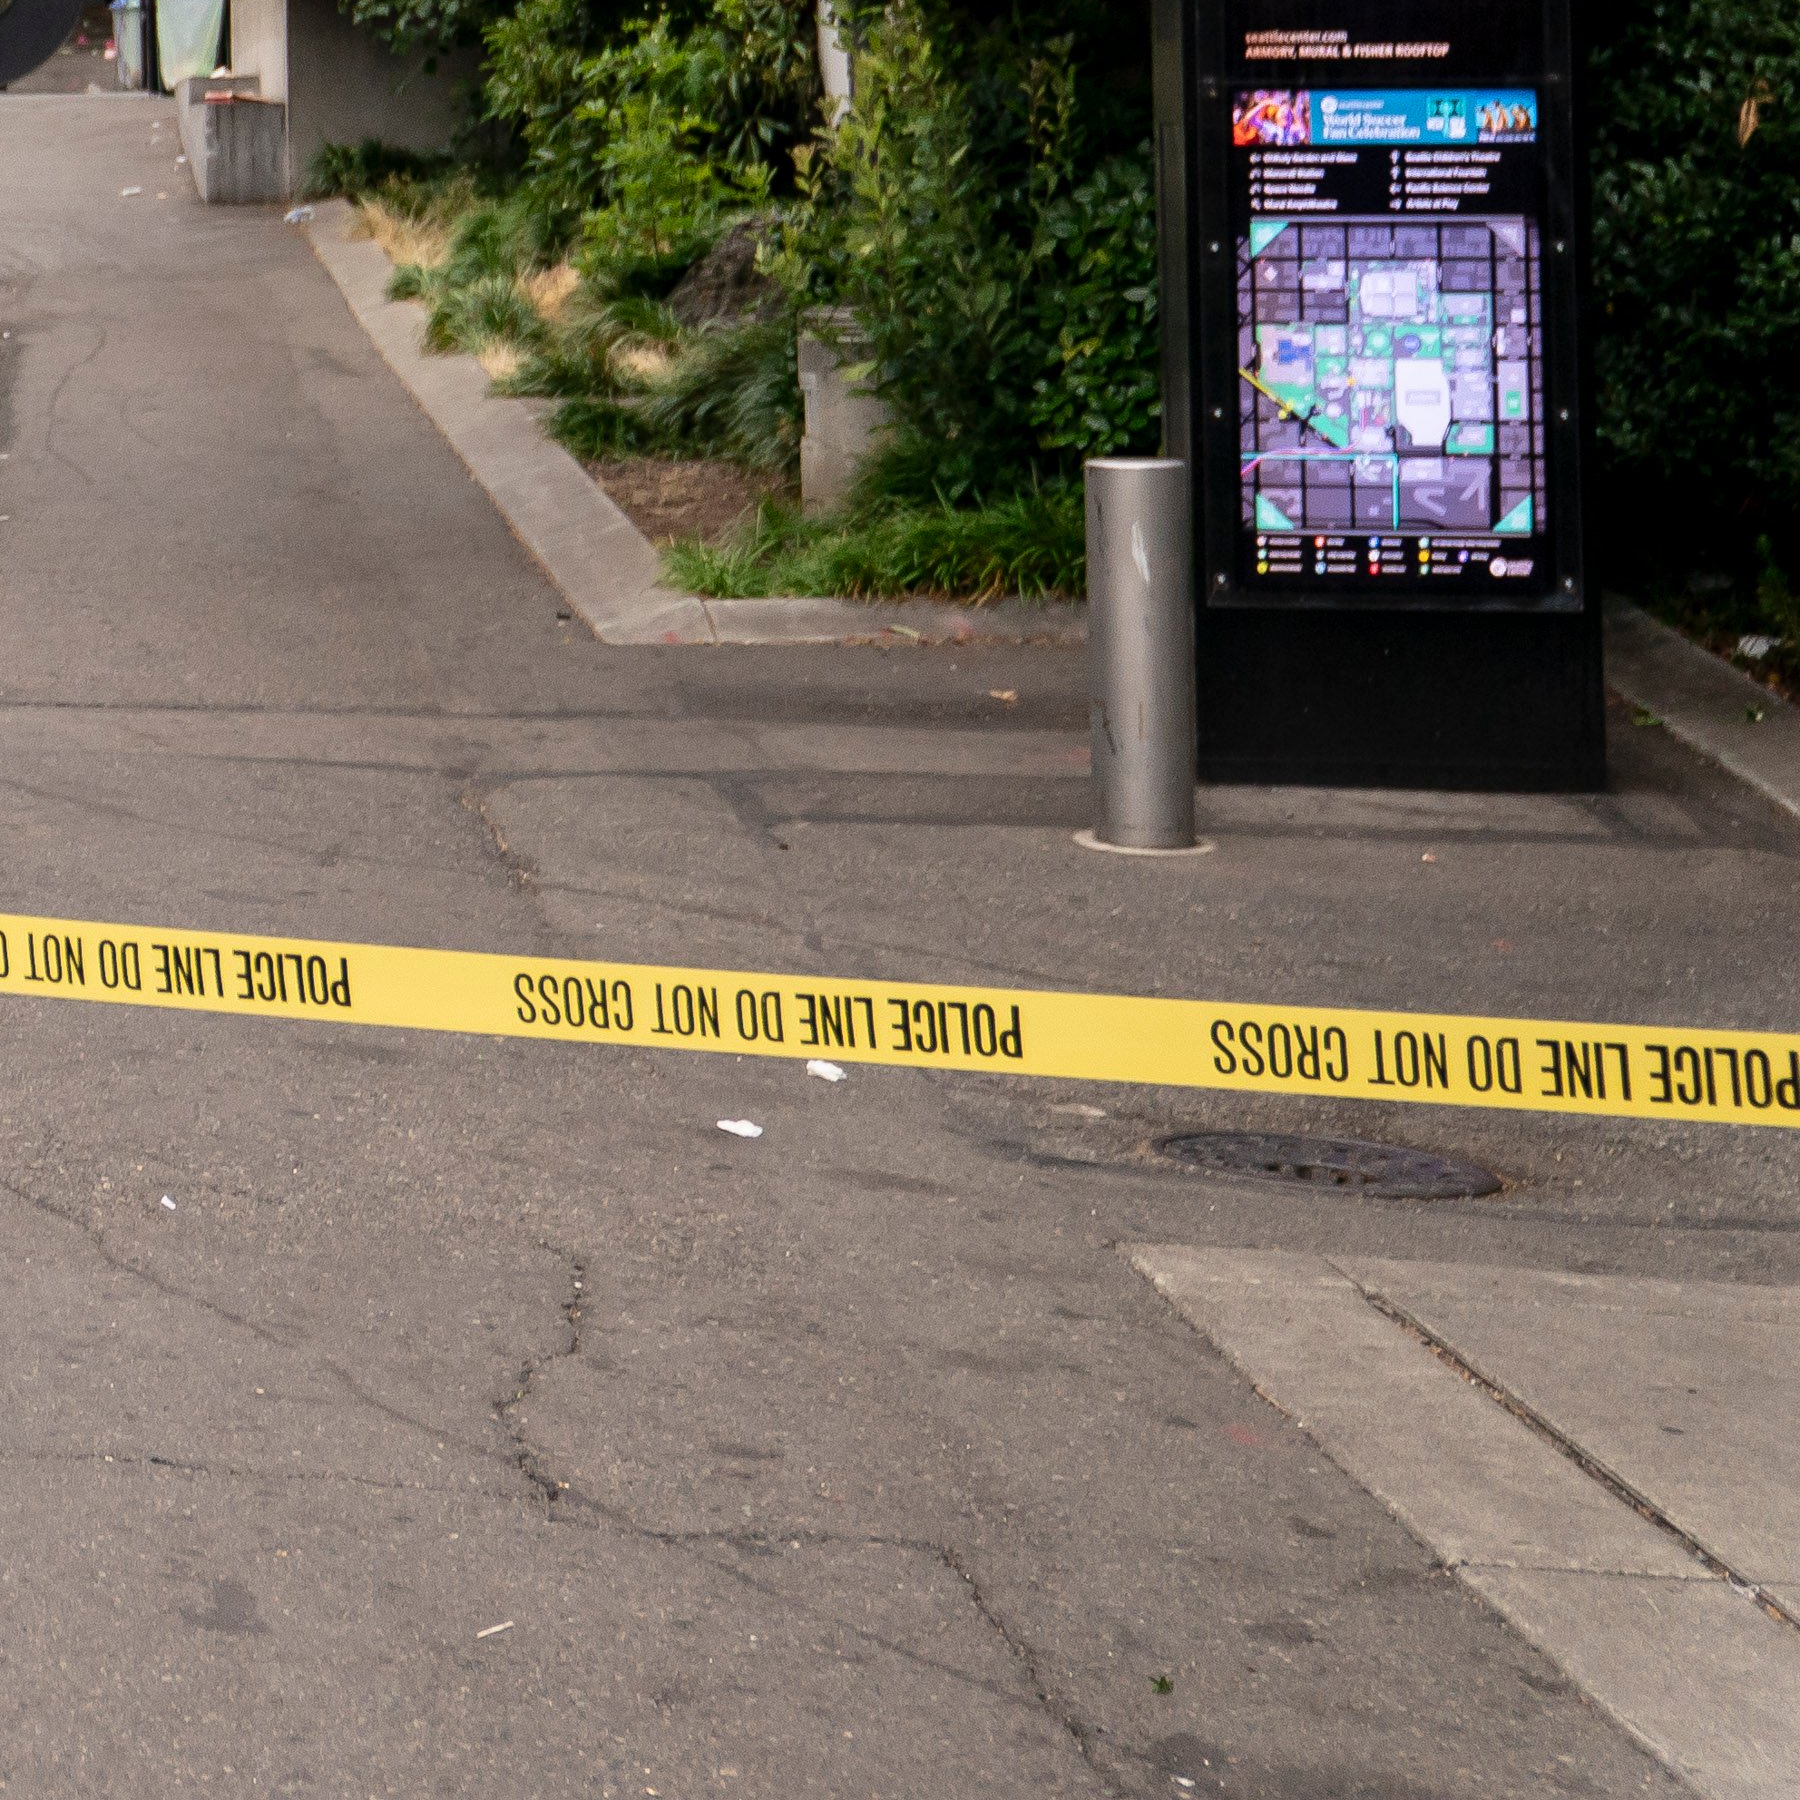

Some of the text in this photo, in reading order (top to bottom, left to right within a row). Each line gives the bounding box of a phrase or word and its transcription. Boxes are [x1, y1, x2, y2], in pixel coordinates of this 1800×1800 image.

[25, 933, 85, 986] NOT
[98, 939, 142, 991] DO
[151, 944, 224, 997] LINE
[233, 950, 352, 1007] POLICE
[514, 973, 1023, 1059] POLICE LINE DO NOT CROSS
[1210, 1019, 1800, 1111] POLICE LINE DO NOT CROSS
